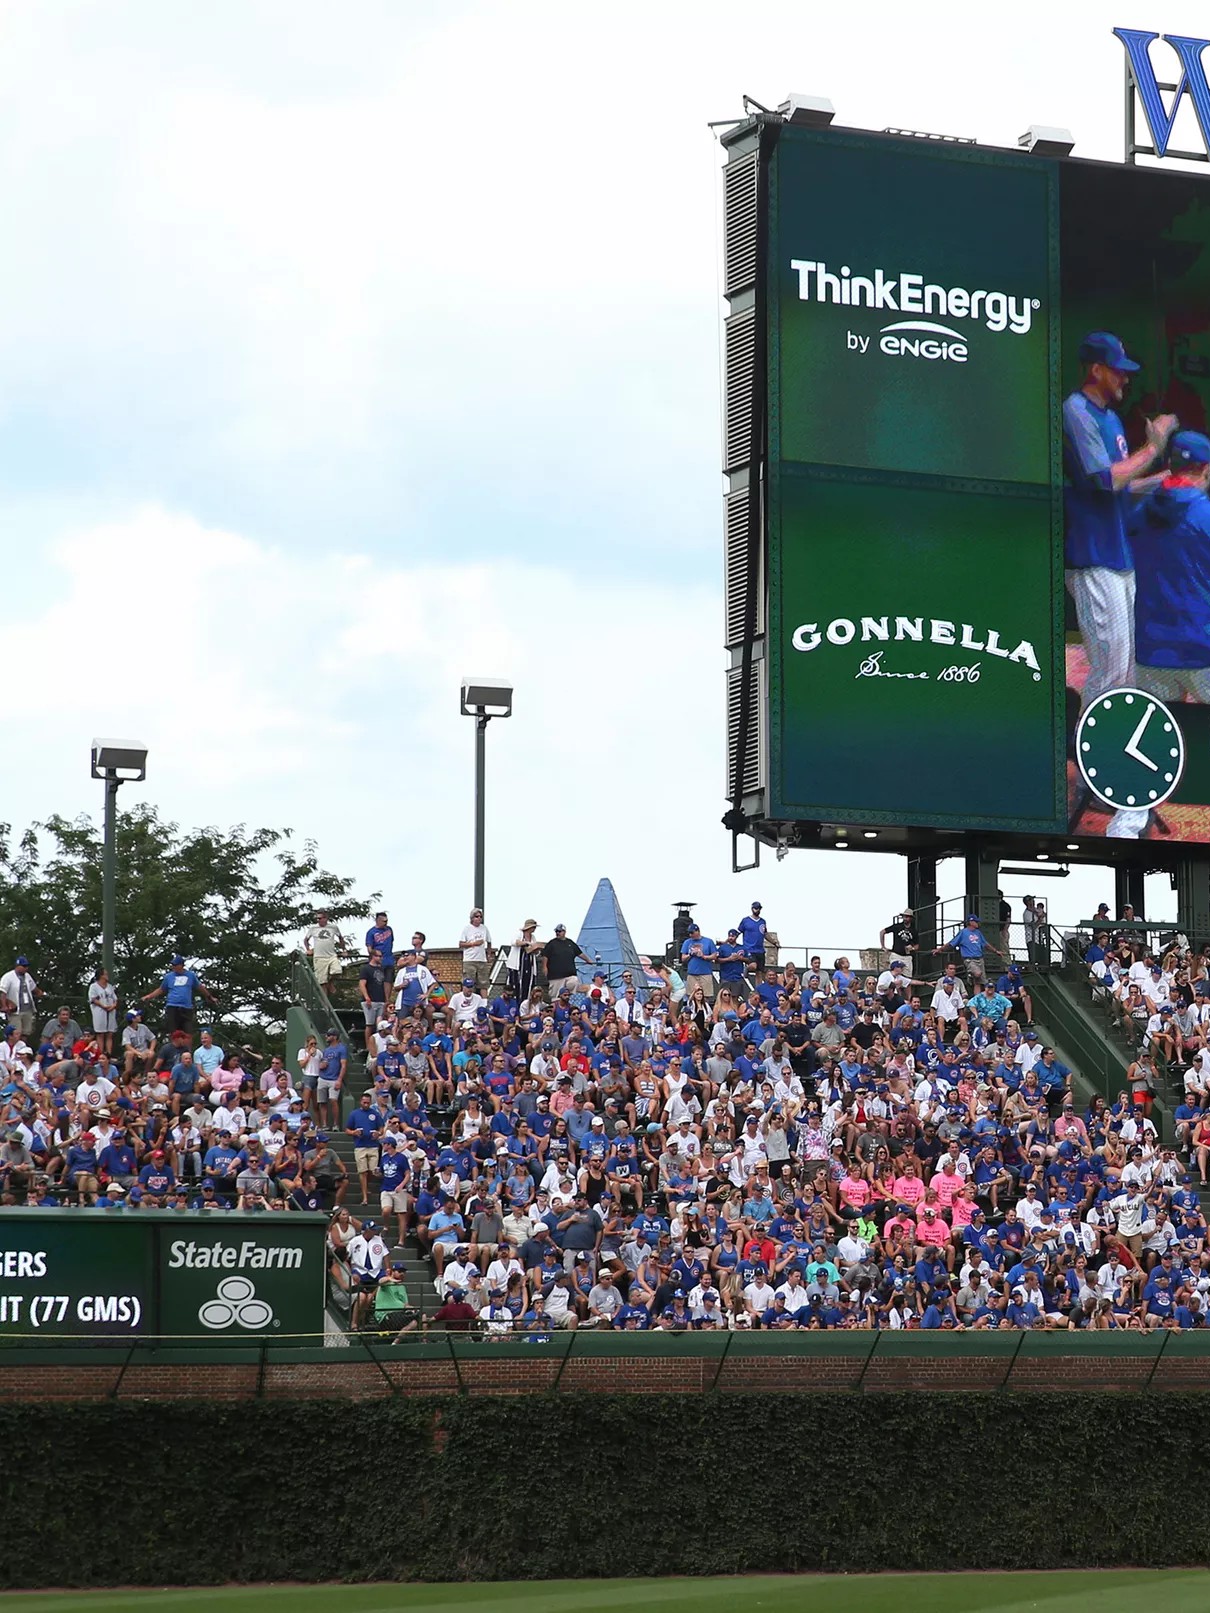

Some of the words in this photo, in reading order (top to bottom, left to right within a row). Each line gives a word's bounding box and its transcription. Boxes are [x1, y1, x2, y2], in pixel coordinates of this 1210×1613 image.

[791, 259, 1031, 334] ThinkEnergy
[847, 331, 870, 353] by
[792, 617, 1041, 671] GONNELLA
[855, 651, 930, 679] Since
[937, 662, 981, 683] 1886
[30, 1296, 70, 1327] (77
[77, 1296, 141, 1327] GMS)
